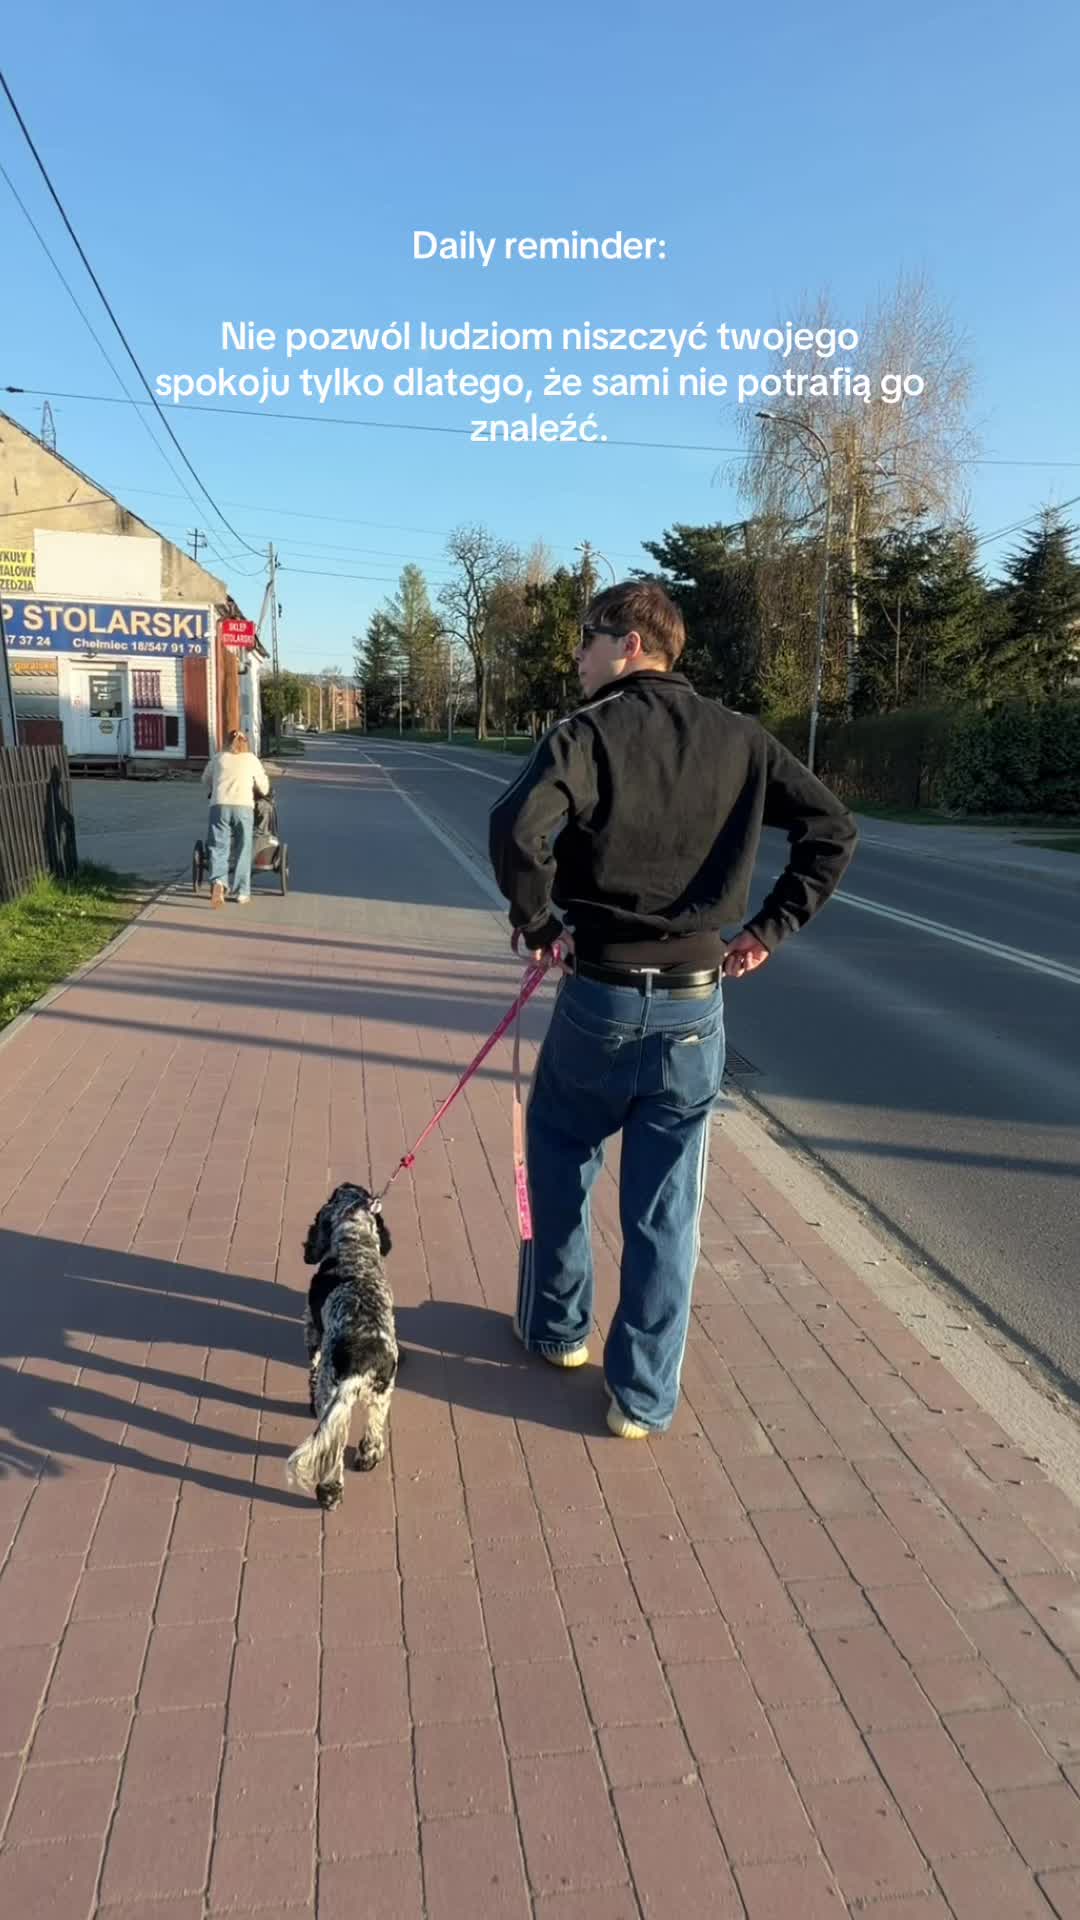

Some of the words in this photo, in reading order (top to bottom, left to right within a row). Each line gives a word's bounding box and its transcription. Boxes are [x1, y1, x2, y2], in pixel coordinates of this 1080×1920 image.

[23, 604, 202, 639] STOLARSKI
[19, 635, 33, 646] 37
[36, 636, 51, 647] 24
[131, 641, 168, 653] 18/547
[171, 643, 184, 653] 91
[187, 644, 202, 655] 70
